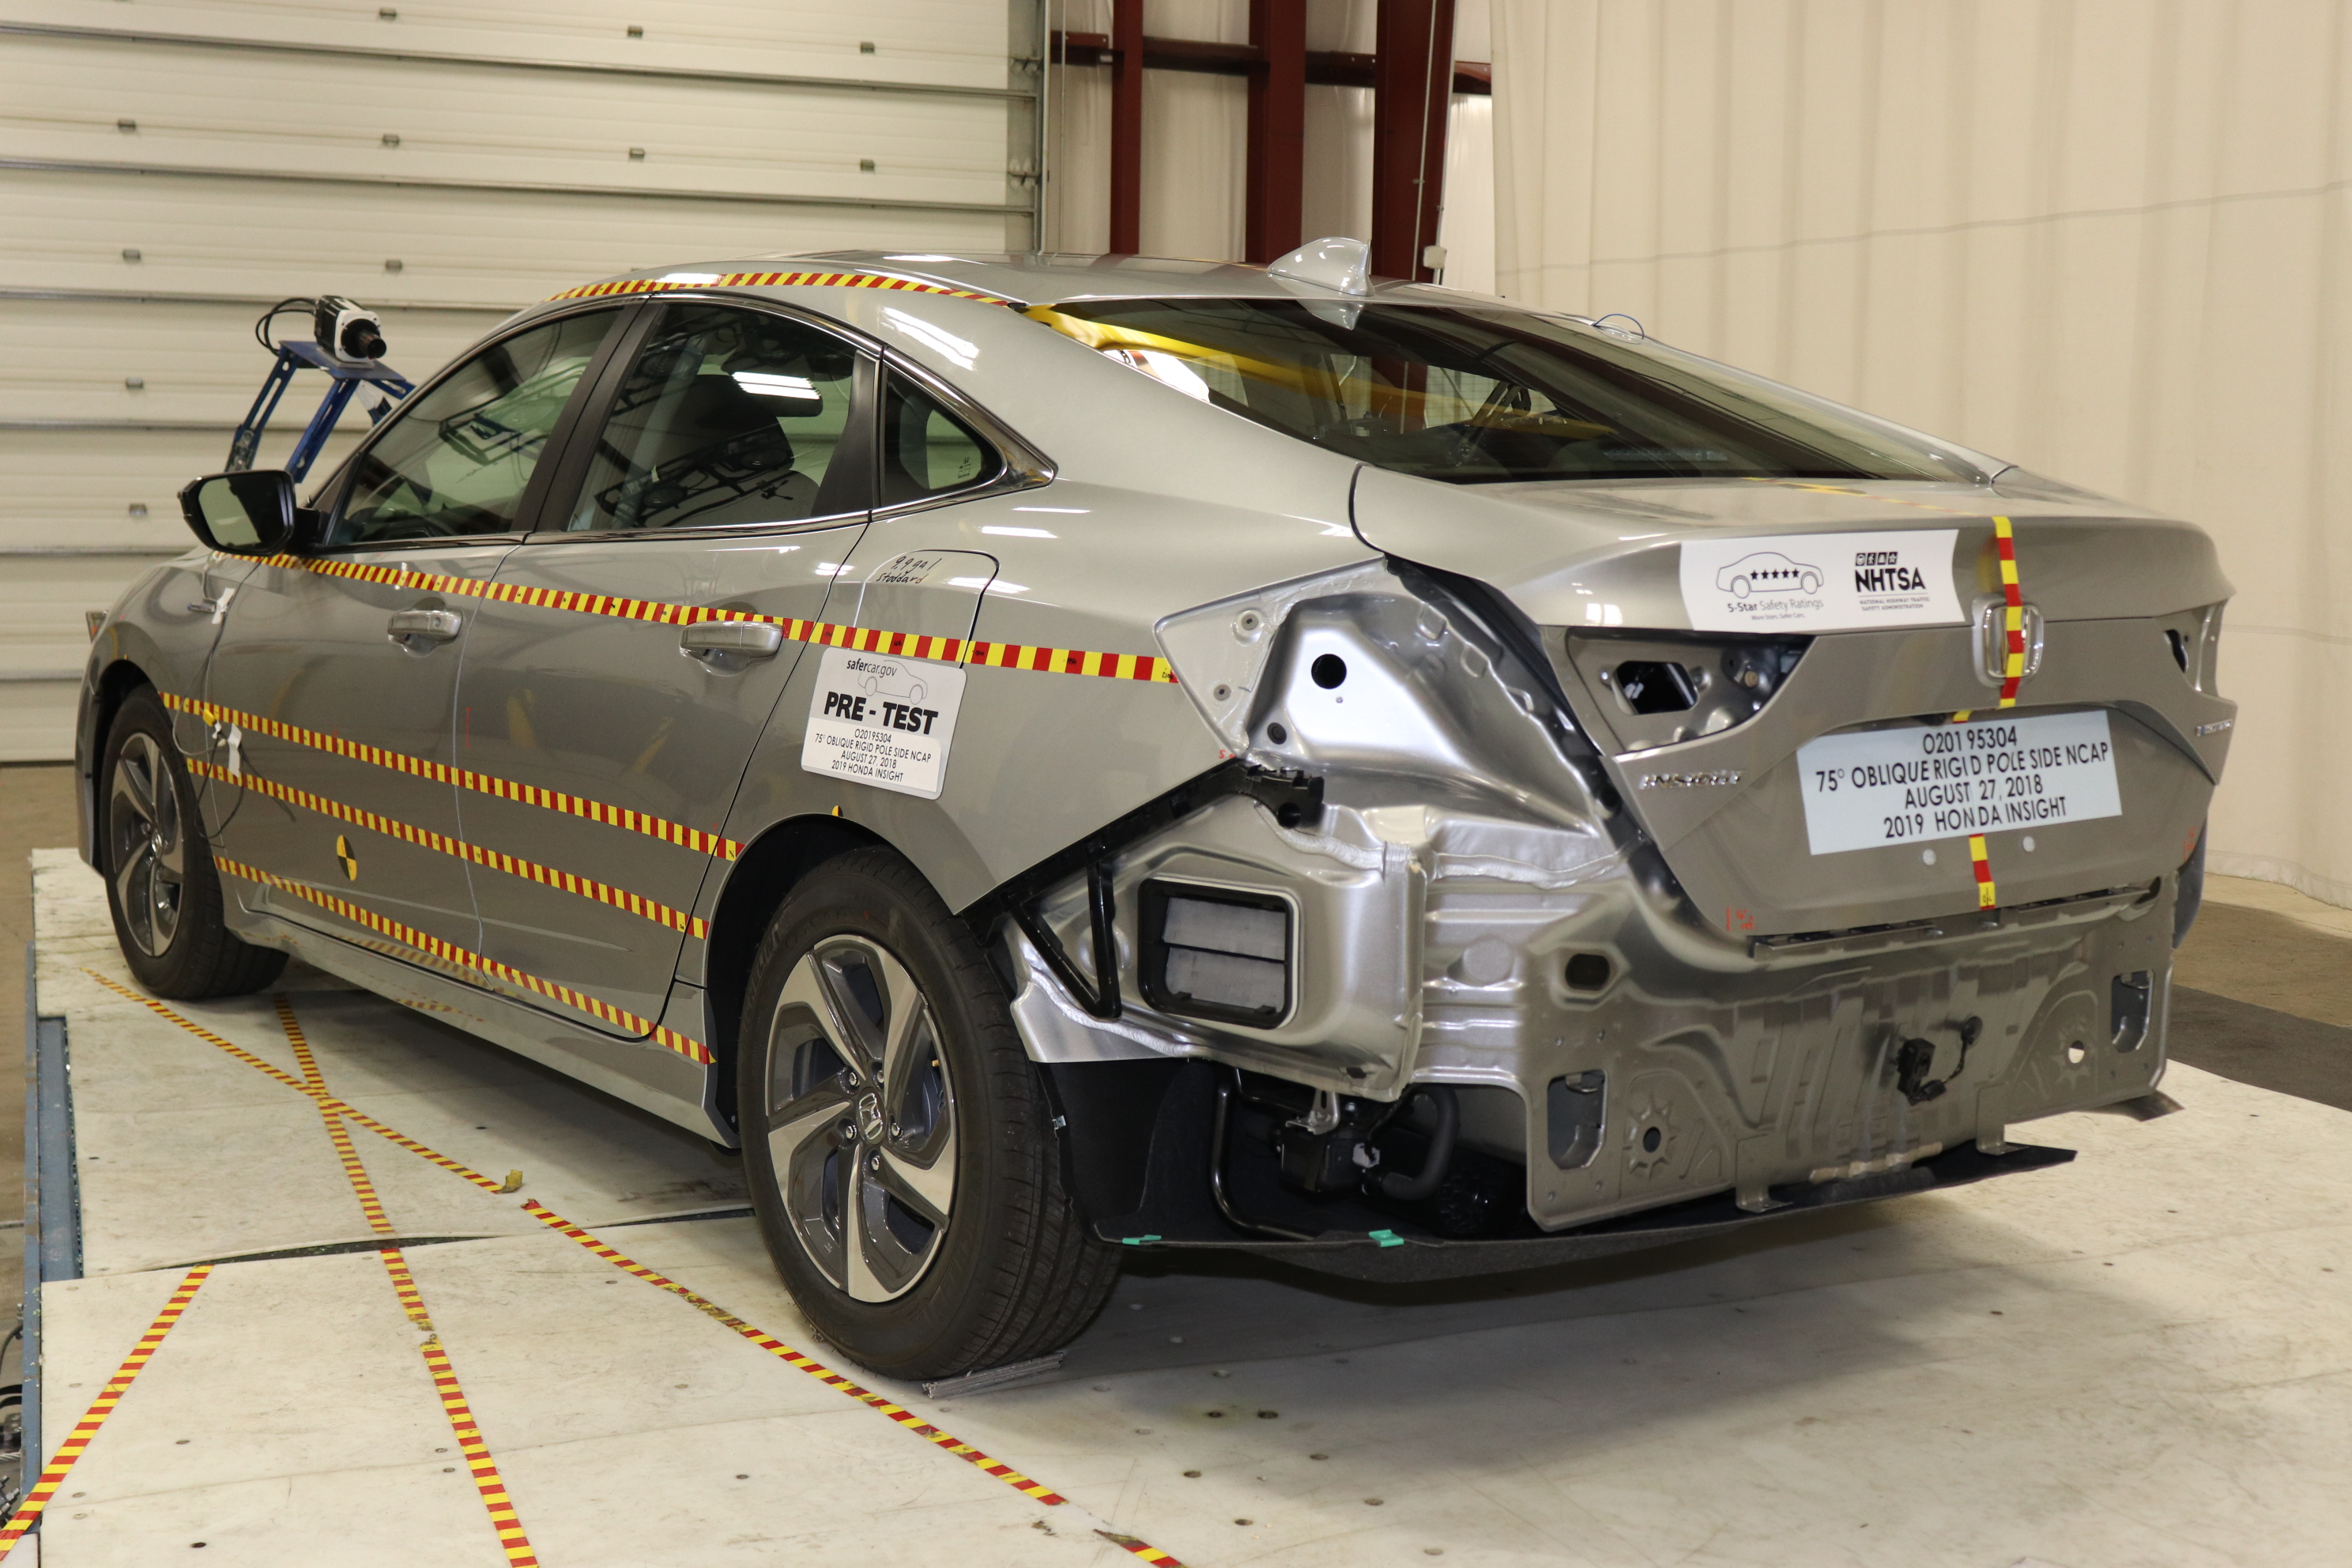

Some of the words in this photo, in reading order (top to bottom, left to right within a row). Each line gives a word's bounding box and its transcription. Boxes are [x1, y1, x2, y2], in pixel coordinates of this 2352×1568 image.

[1854, 567, 1927, 592] NHTSA
[1728, 602, 1757, 612] 5-Star
[1759, 600, 1788, 612] Safety
[1789, 598, 1824, 610] Ratings
[846, 658, 898, 678] safercar.gov
[824, 691, 866, 722] PRE
[883, 701, 939, 735] TEST
[827, 736, 854, 749] OBLIQUE
[855, 740, 873, 752] RIGID
[875, 744, 892, 756] POLE
[894, 747, 909, 759] SIDE
[910, 751, 931, 763] NCAP
[841, 751, 868, 763] AUGUST
[869, 755, 878, 767] 27,
[880, 757, 897, 768] 2018
[831, 760, 846, 771] 2019
[848, 763, 873, 777] HONDA
[875, 768, 903, 782] INSIGHT
[1816, 768, 1845, 792] 75°
[1852, 760, 1929, 789] OBLIQUE
[1934, 756, 1981, 780] RIGID
[1987, 751, 2026, 774] POLE
[2030, 747, 2062, 769] SIDE
[2066, 742, 2108, 765] NCAP
[1905, 782, 1969, 809] AUGUST
[1979, 779, 2001, 801] 27,
[2006, 774, 2043, 797] 2018
[1884, 813, 1924, 838] 2019
[1935, 805, 2002, 831] HONDA
[2005, 797, 2066, 824] INSIGHT
